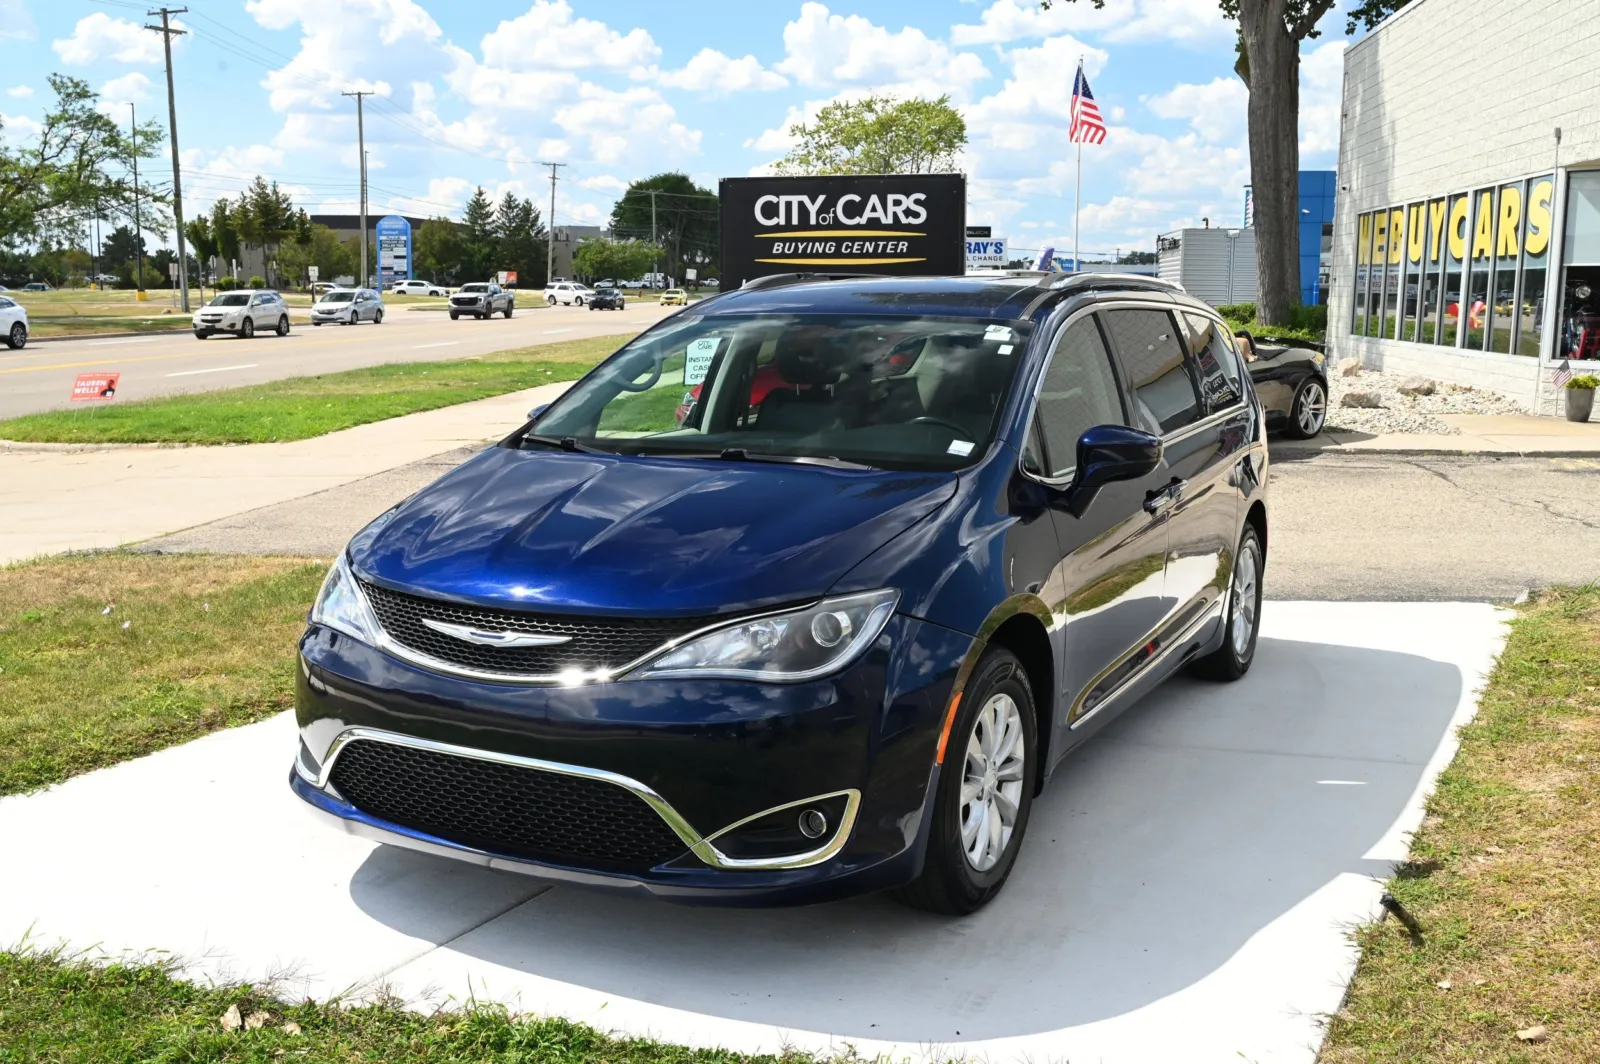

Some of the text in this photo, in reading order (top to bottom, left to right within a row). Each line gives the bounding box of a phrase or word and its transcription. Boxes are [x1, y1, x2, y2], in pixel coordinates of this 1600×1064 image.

[754, 193, 928, 226] CITY of CARS
[1388, 200, 1446, 264] BUY
[1447, 180, 1553, 259] CARS
[772, 241, 909, 254] BUYING CENTER
[74, 386, 99, 394] WELLS
